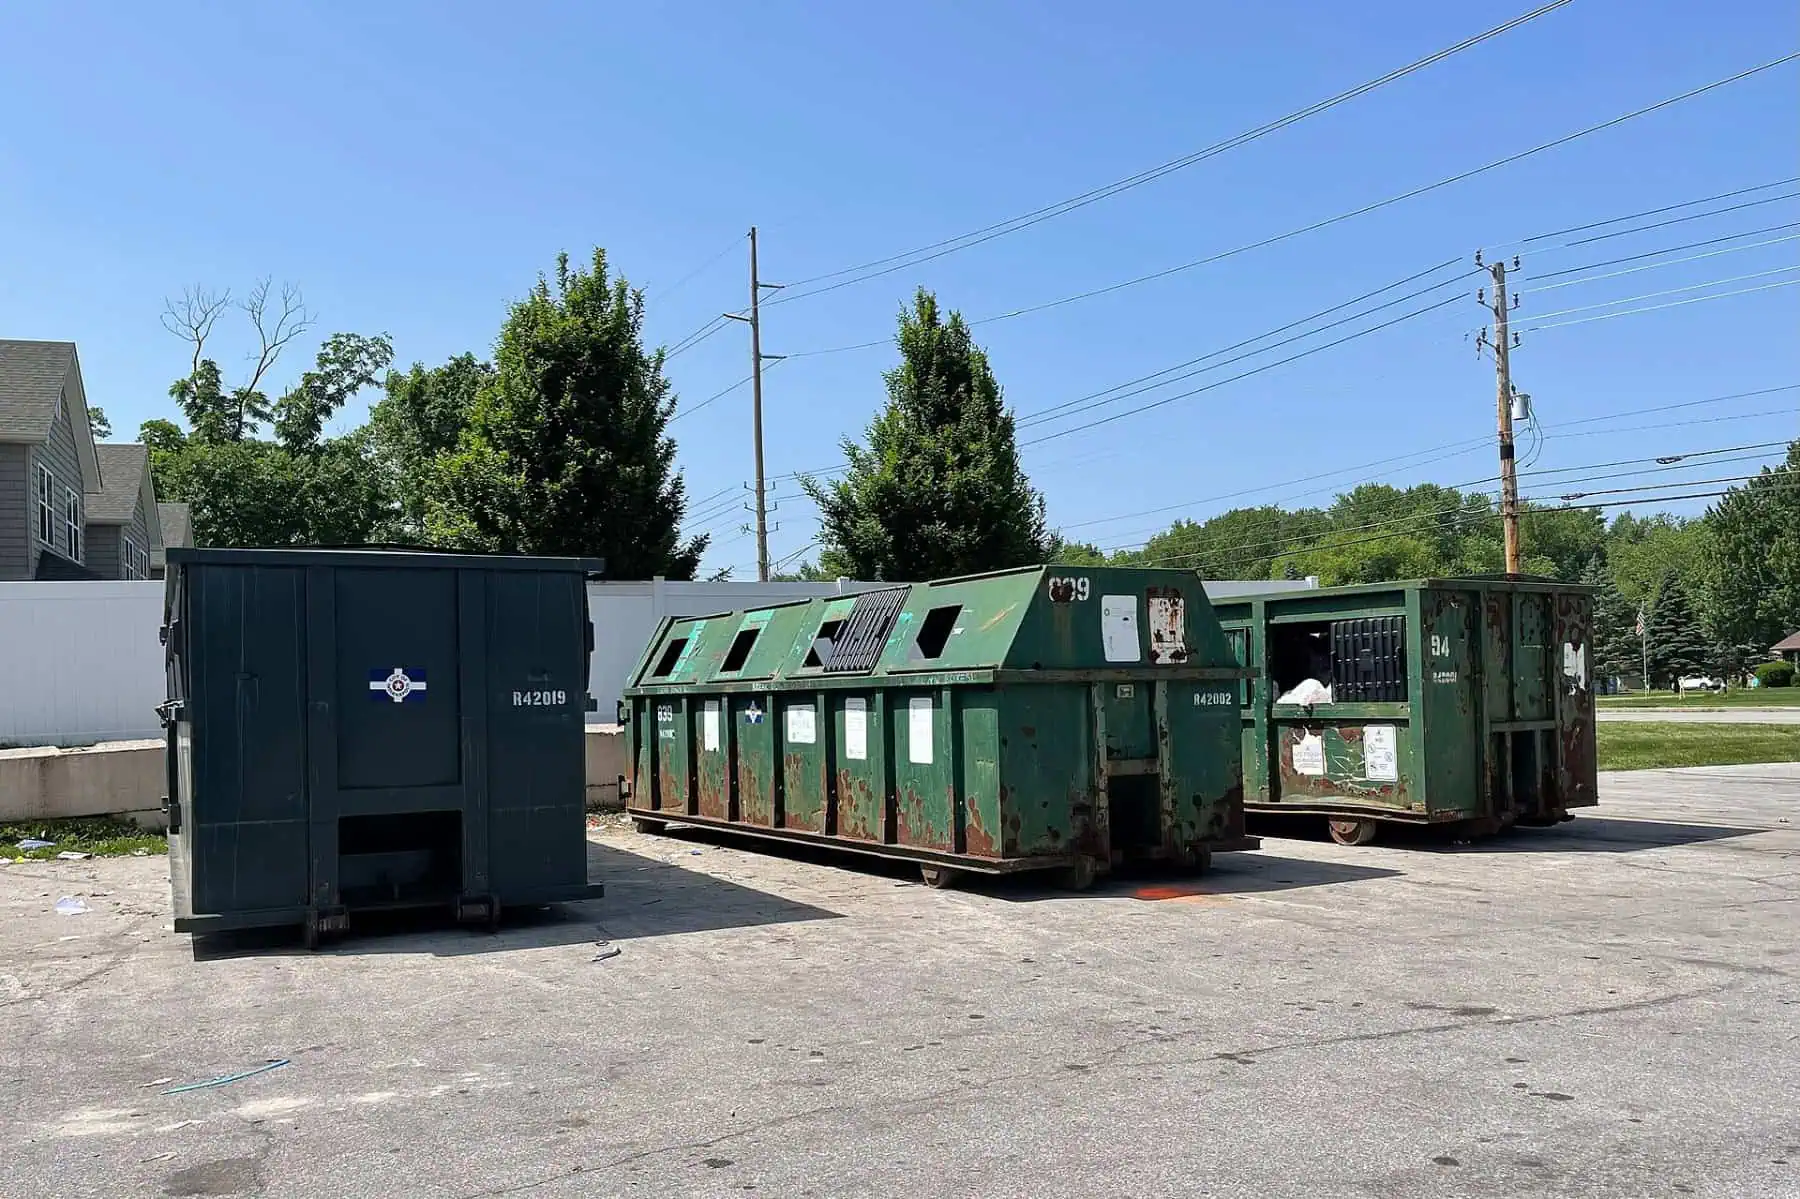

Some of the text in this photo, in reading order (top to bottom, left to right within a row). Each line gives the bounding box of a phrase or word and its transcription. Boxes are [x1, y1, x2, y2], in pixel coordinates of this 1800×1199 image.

[1431, 634, 1450, 657] 94
[512, 690, 566, 706] R42019
[1193, 692, 1232, 706] R42002
